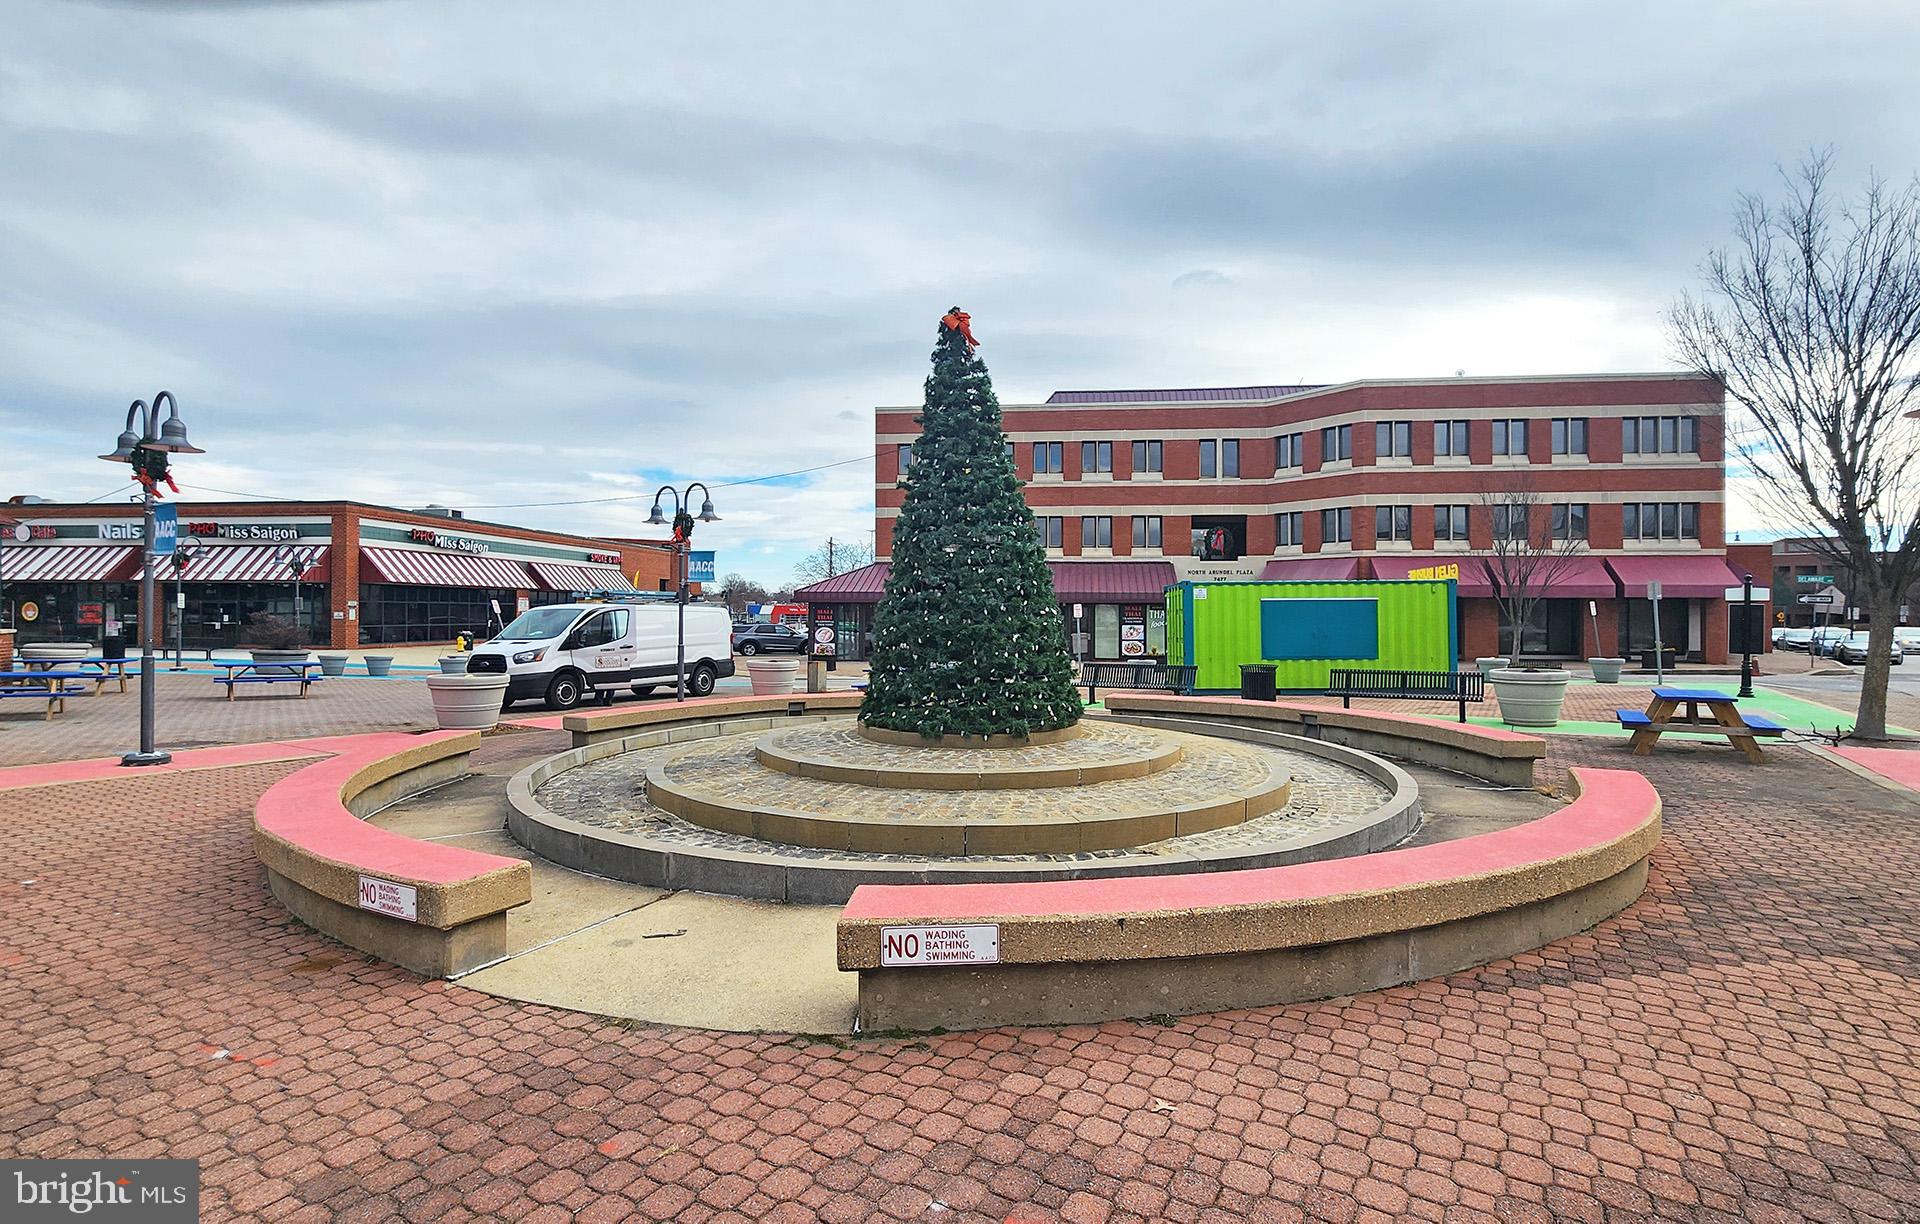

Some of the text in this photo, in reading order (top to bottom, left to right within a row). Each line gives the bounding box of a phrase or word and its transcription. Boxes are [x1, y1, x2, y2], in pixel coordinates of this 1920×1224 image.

[99, 524, 141, 539] Nails
[189, 522, 298, 541] PHO Miss Saigon
[412, 529, 489, 553] PHO Miss Saigon
[688, 561, 714, 572] AACC
[1149, 610, 1165, 619] THA
[362, 882, 399, 904] NO WADING
[379, 892, 401, 905] BATHING
[379, 901, 405, 915] SWIMMING
[888, 930, 966, 958] NO WADING
[925, 940, 970, 950] BATHING
[925, 950, 975, 961] SWIMMING
